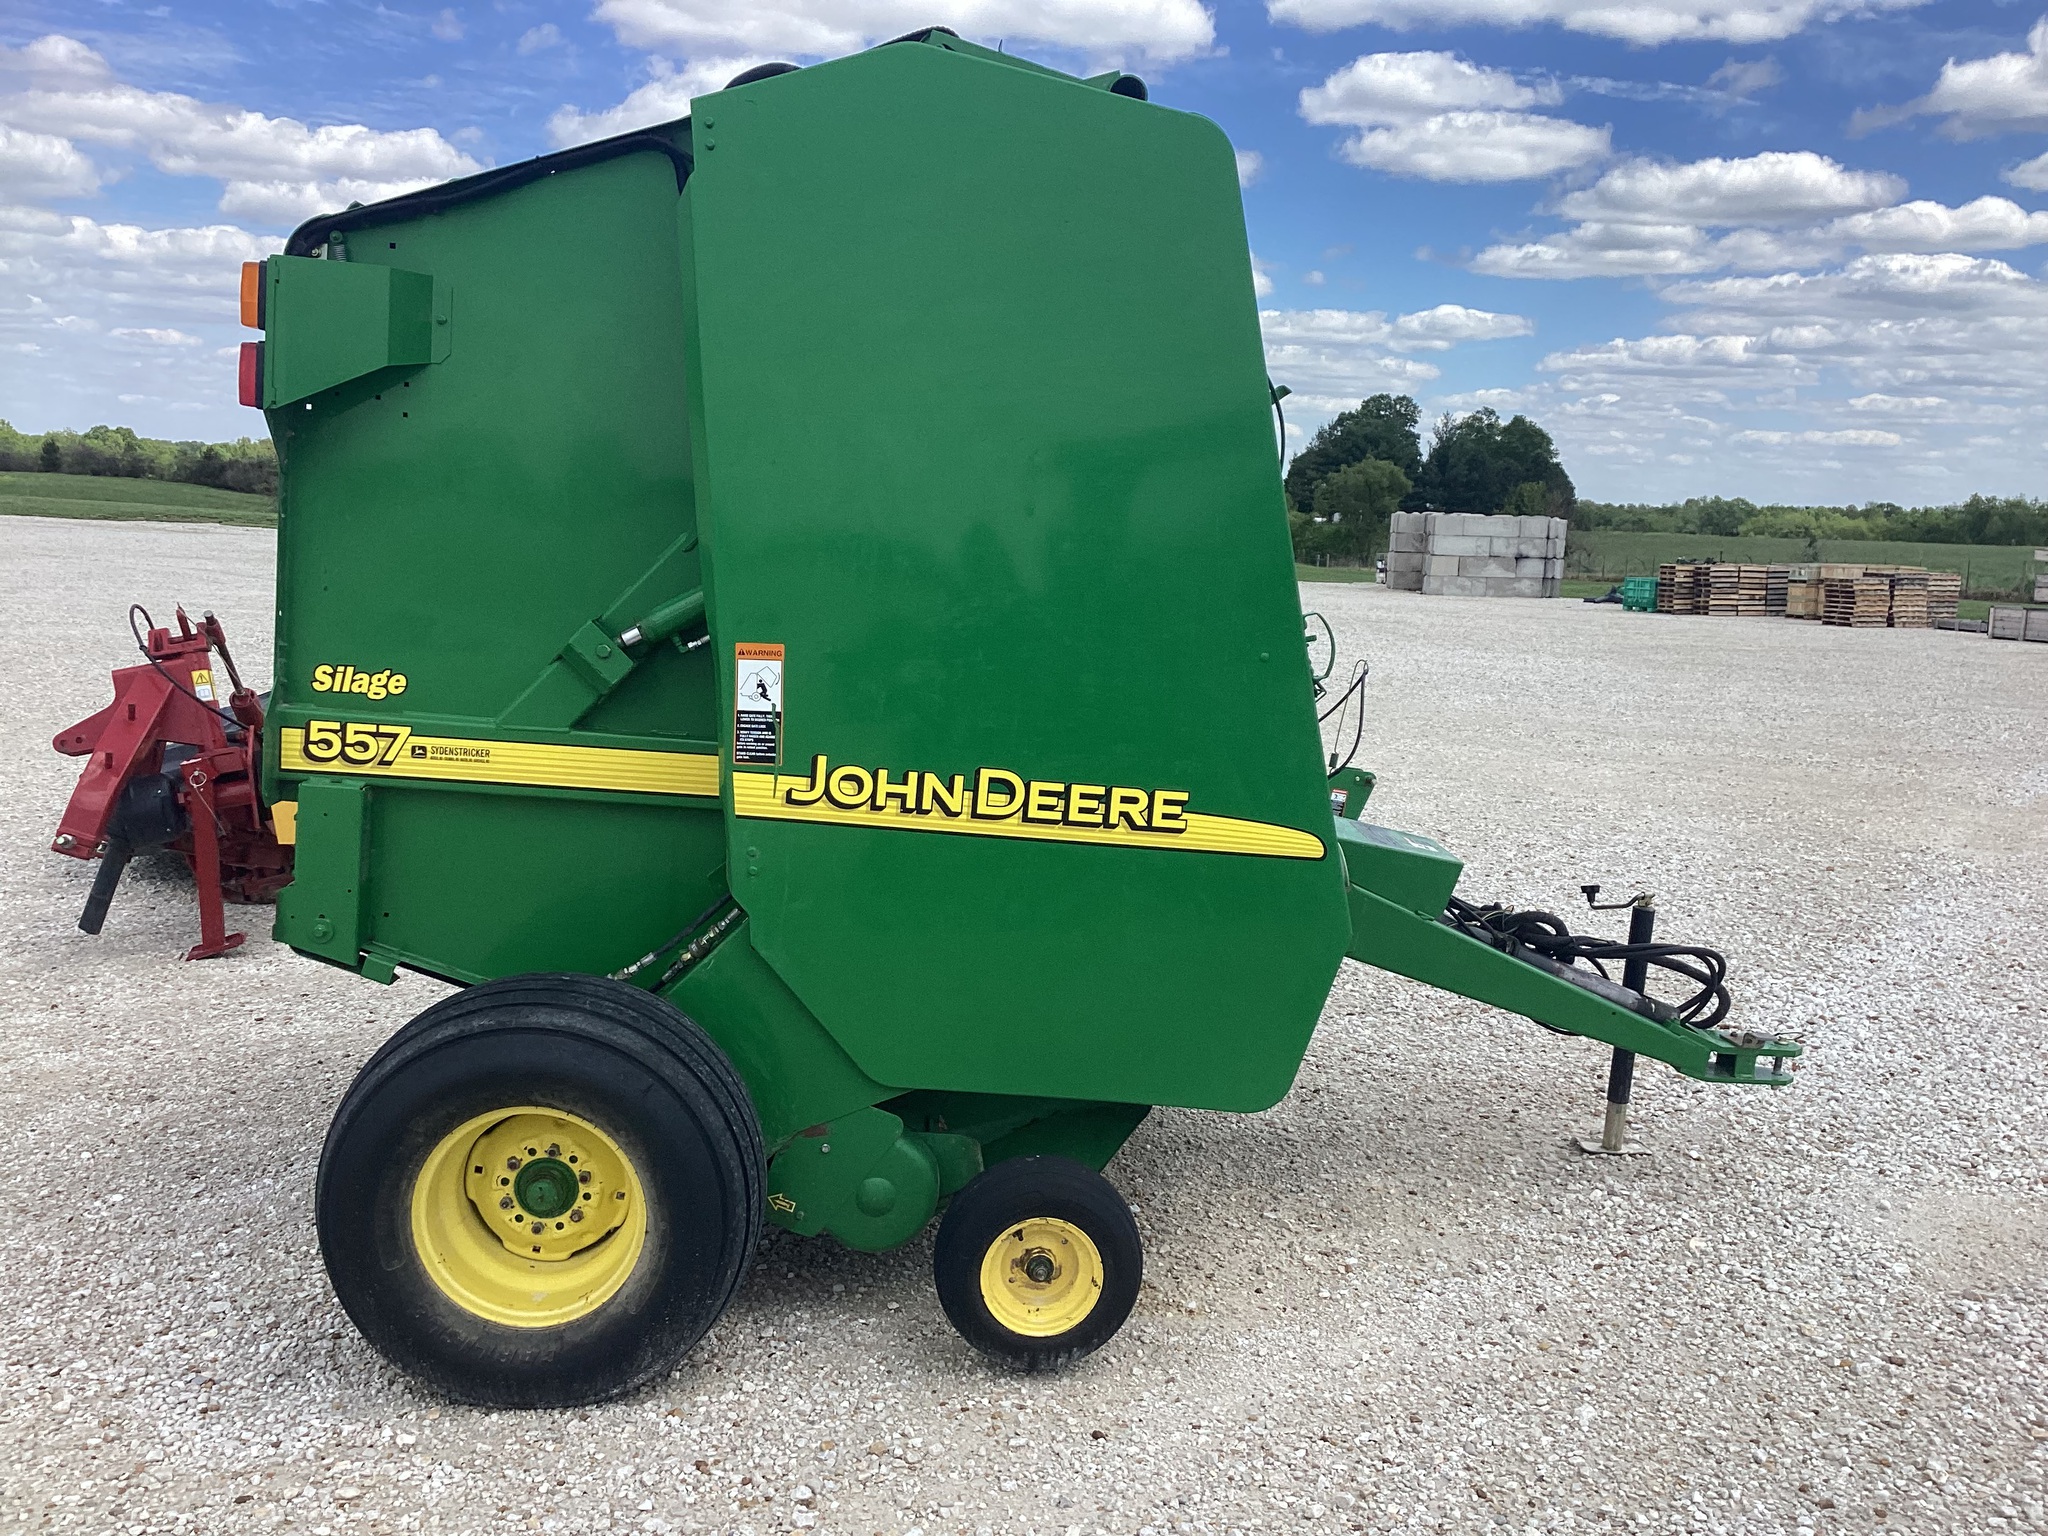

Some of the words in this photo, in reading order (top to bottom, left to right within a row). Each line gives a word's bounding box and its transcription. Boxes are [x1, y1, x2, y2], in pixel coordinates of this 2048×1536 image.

[745, 649, 782, 657] WARNING
[311, 663, 408, 701] Silage
[303, 719, 412, 766] 557
[430, 745, 490, 758] SYDENSTRICKER
[786, 754, 965, 817] JOHN
[970, 766, 1190, 834] DEERE
